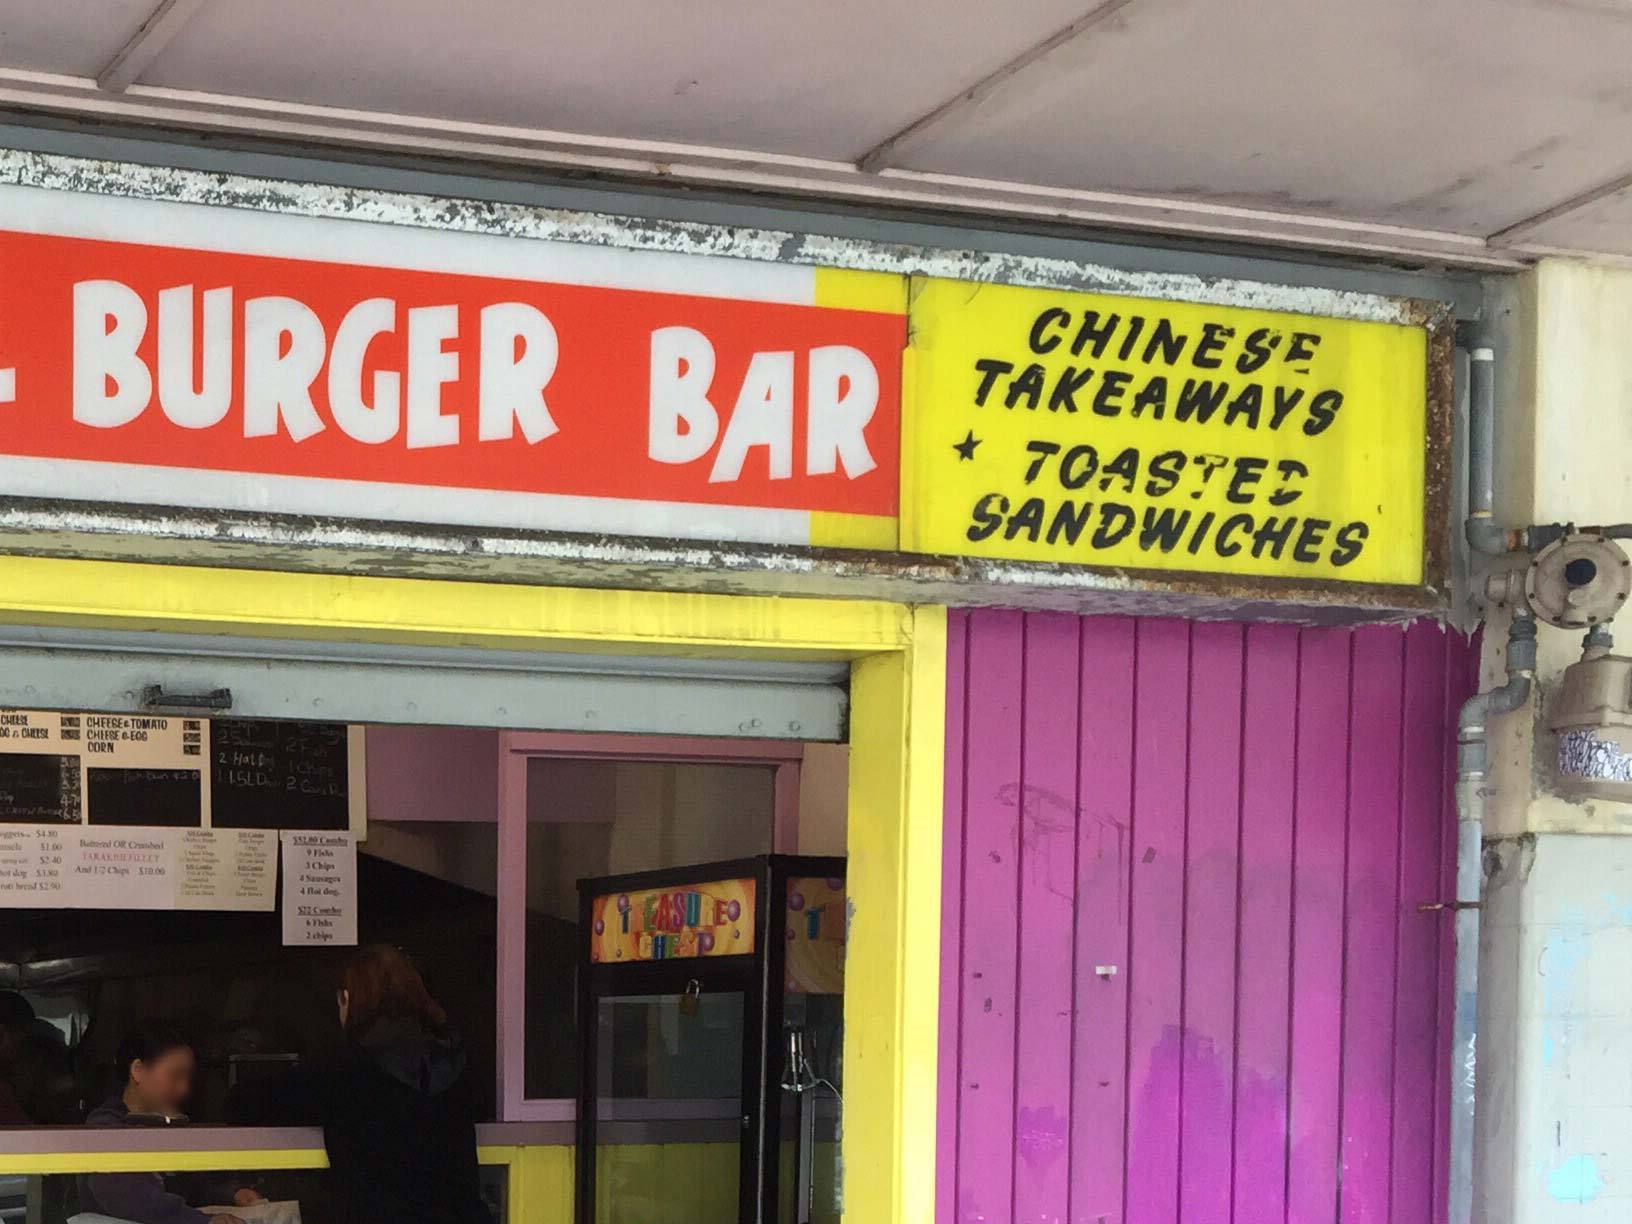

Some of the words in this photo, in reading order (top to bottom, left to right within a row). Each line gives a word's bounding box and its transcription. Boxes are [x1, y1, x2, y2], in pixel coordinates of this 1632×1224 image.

[1028, 307, 1321, 374] CHINESE
[72, 279, 560, 450] BURGER
[648, 326, 880, 483] BAR
[974, 359, 1344, 436] TAKEAWAYS
[1024, 440, 1309, 506] TOASTED
[967, 492, 1369, 567] SANDWICHES
[87, 717, 123, 729] CHEESE
[131, 719, 168, 730] TOMATO
[87, 729, 119, 740] CHEESE
[131, 731, 147, 741] EGG
[88, 742, 114, 753] CORN
[113, 840, 126, 848] OR
[75, 865, 91, 873] And
[108, 866, 129, 876] Chips
[312, 861, 335, 871] Chips
[307, 887, 321, 895] Hot
[313, 932, 333, 942] chips
